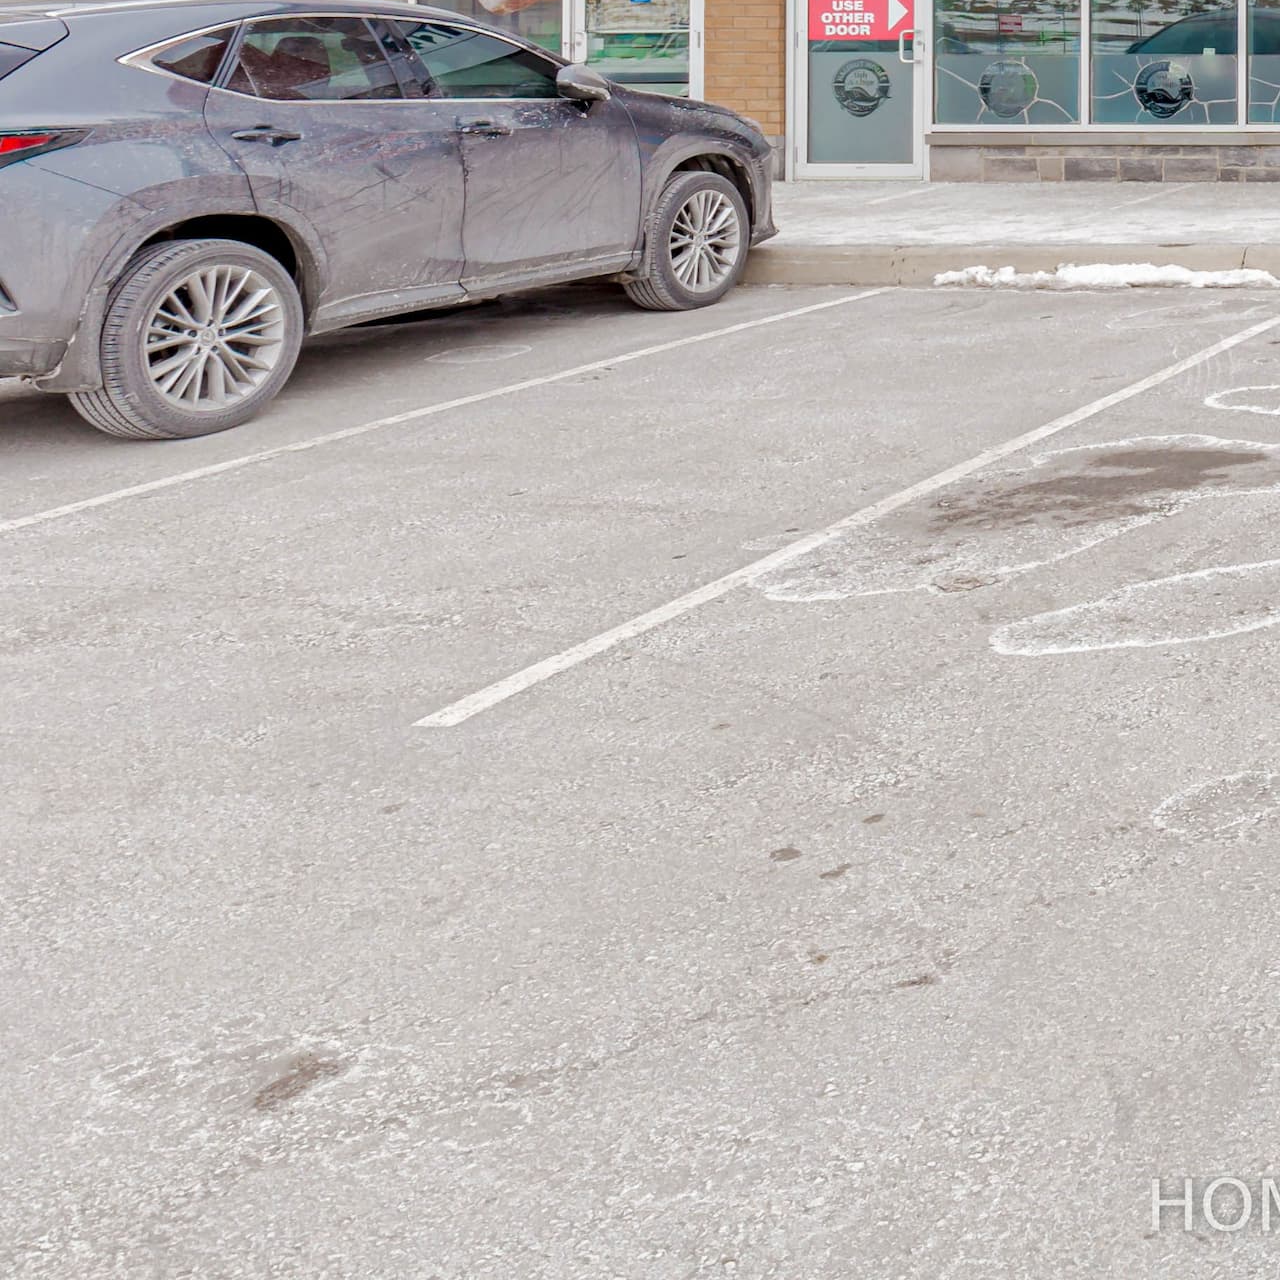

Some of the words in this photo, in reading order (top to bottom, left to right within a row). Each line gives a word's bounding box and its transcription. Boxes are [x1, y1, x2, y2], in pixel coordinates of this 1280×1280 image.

[832, 0, 864, 11] USE
[821, 12, 875, 23] OTHER
[825, 24, 871, 36] DOOR
